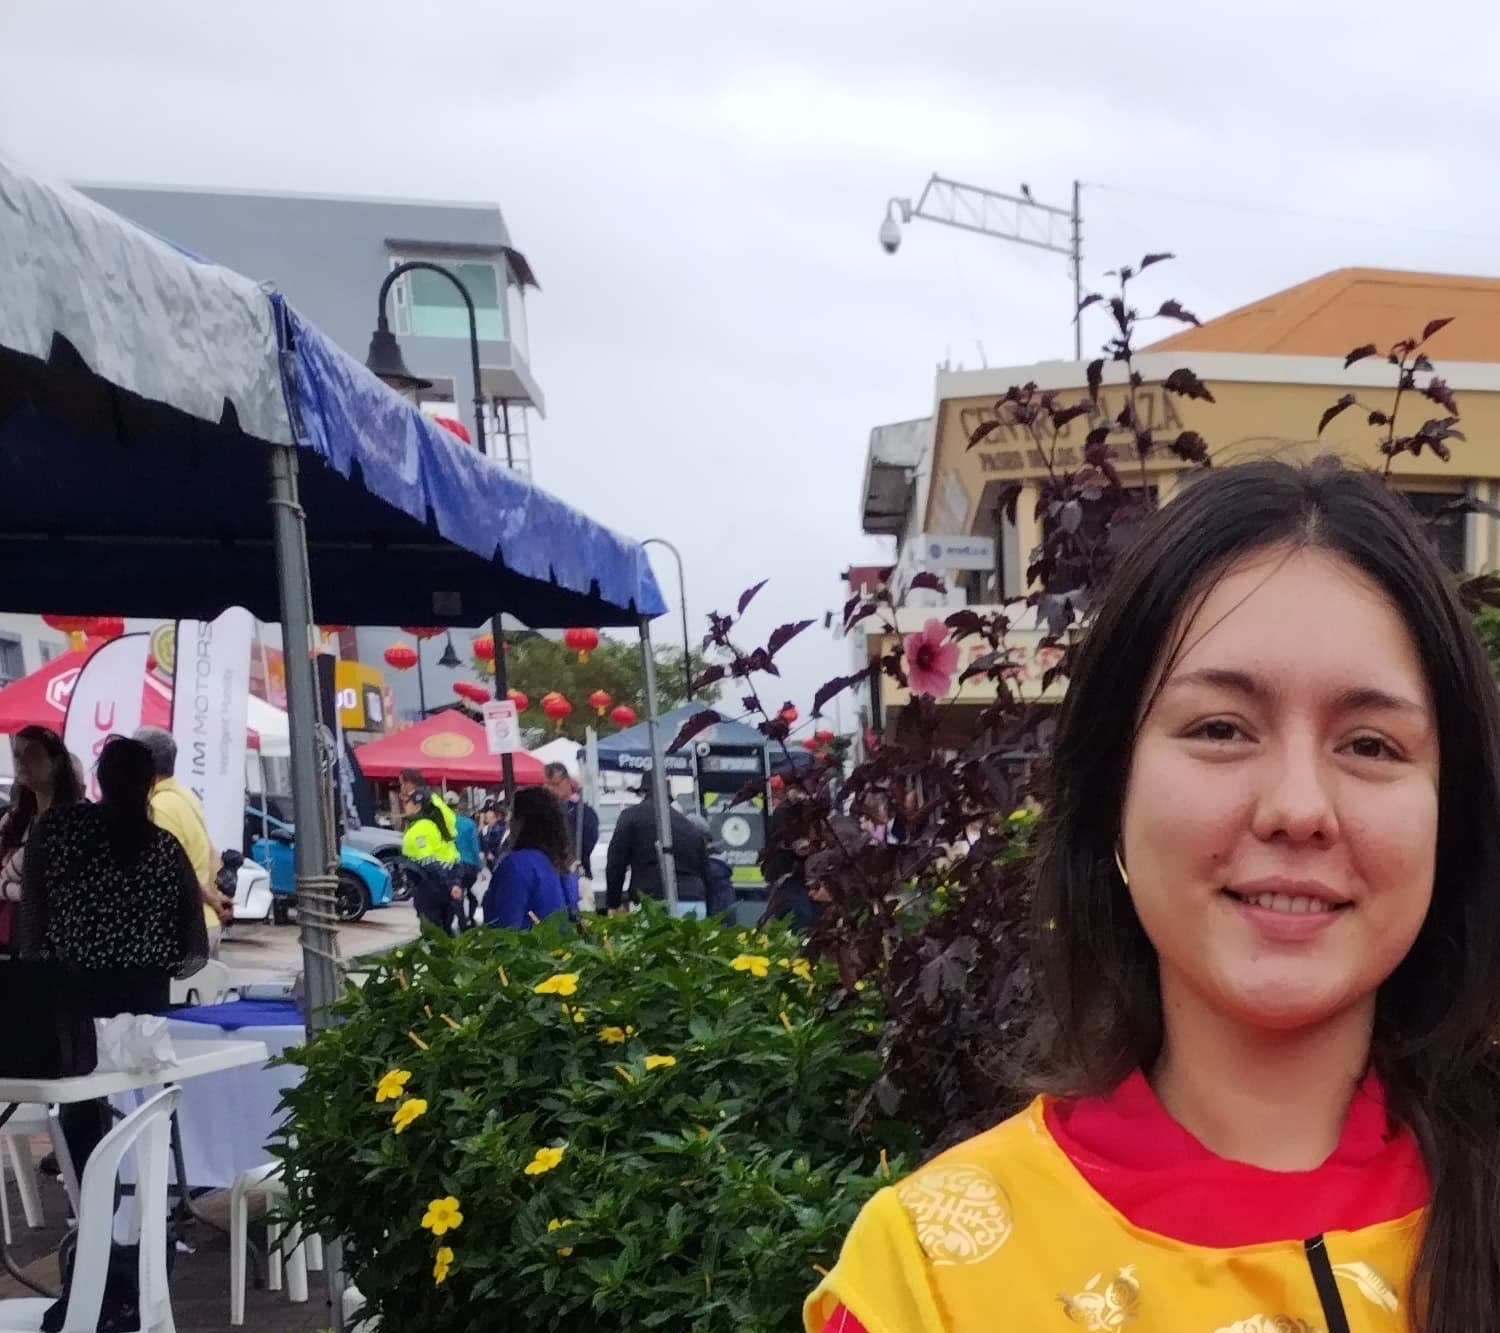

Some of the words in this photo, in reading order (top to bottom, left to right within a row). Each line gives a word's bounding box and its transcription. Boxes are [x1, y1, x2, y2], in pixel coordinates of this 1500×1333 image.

[960, 400, 1071, 444] CENO
[193, 621, 213, 735] MOTORS
[191, 741, 206, 776] IM
